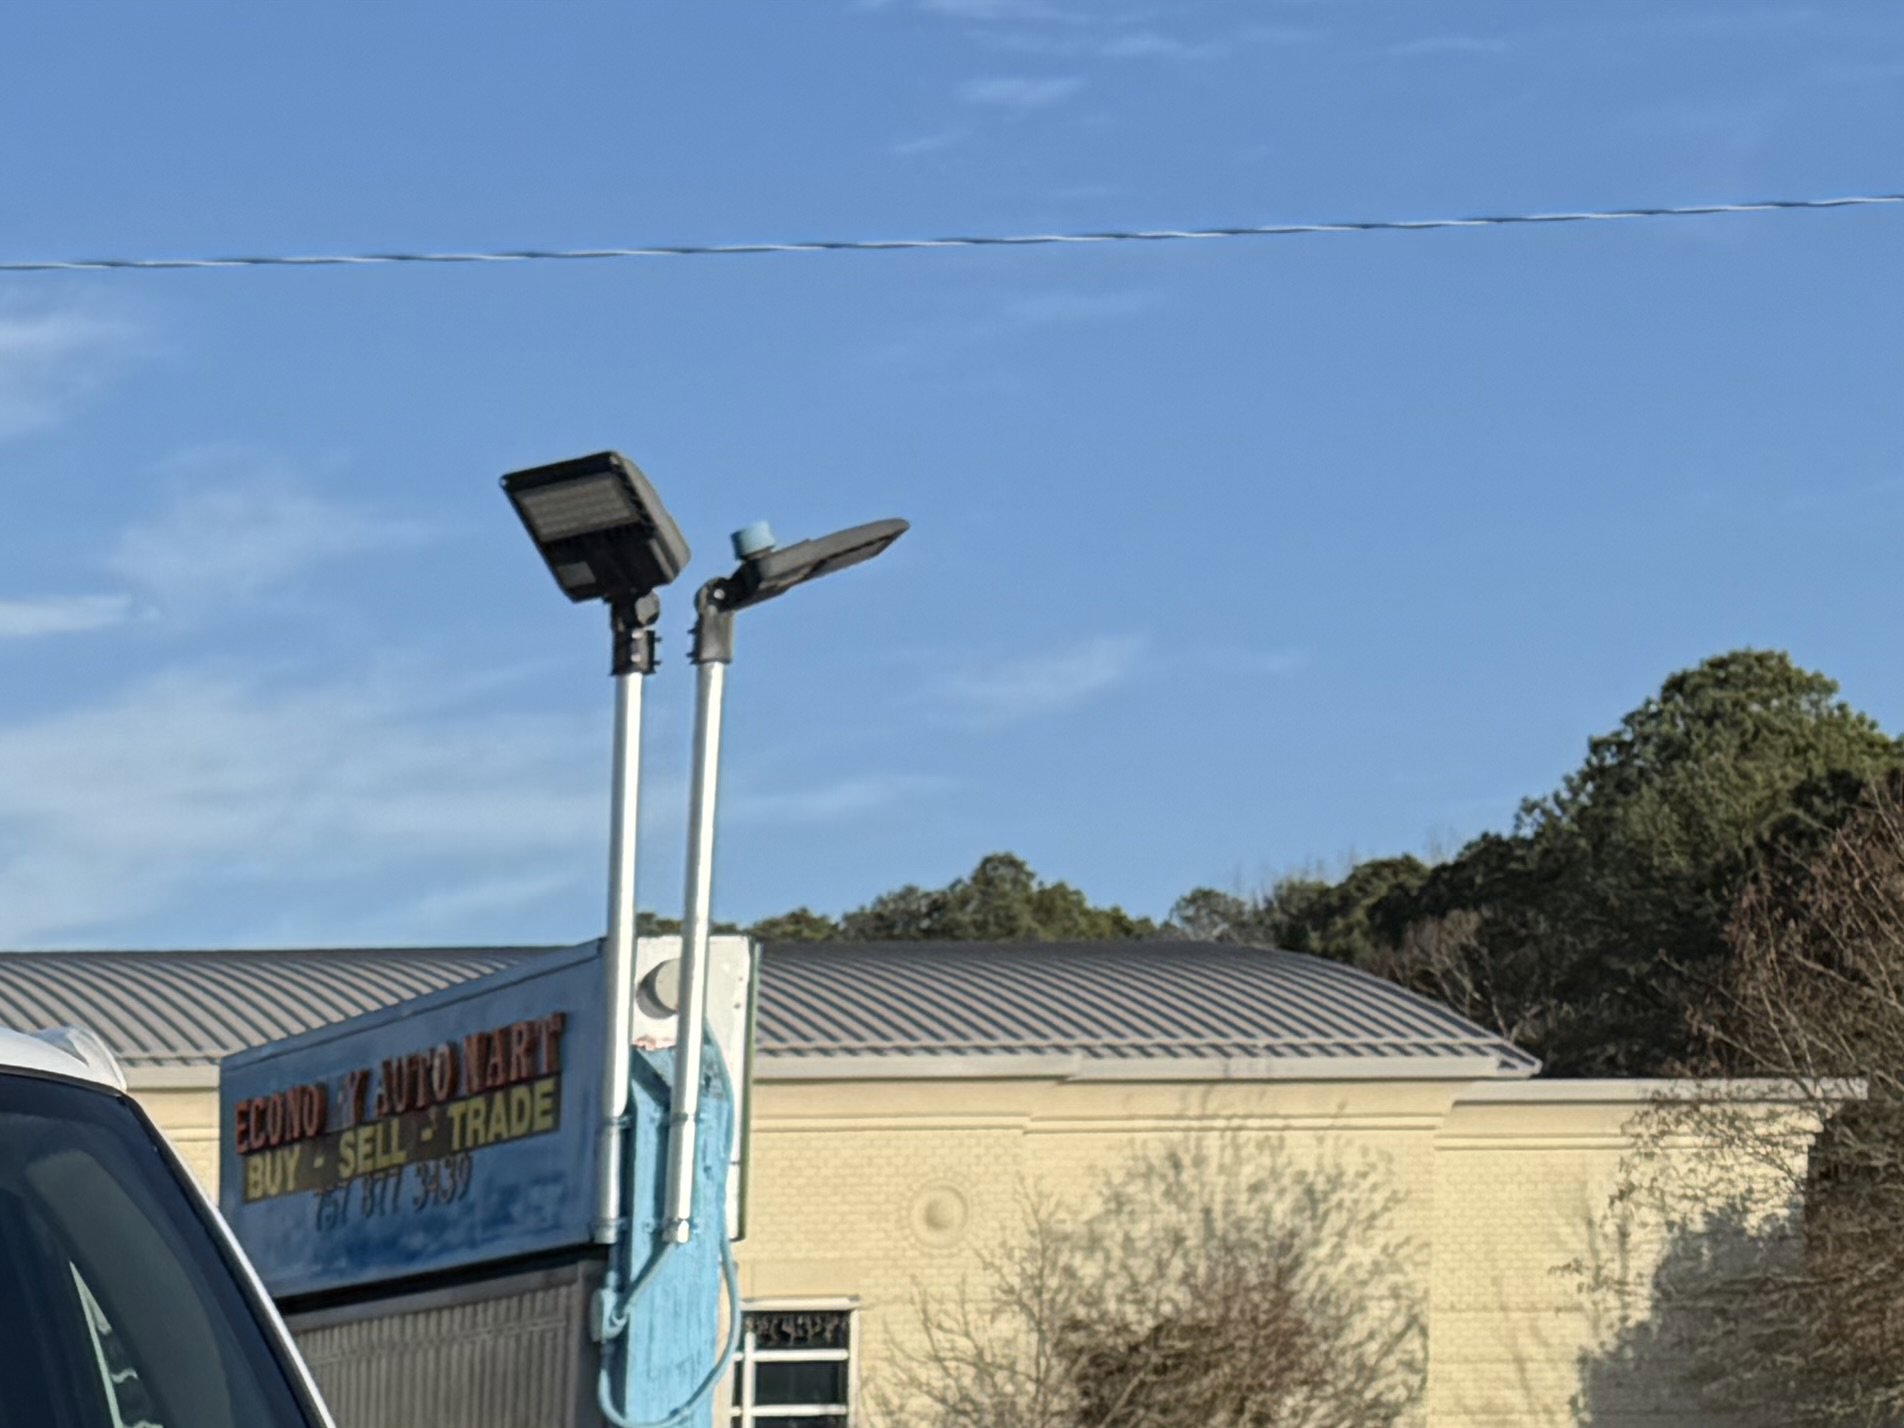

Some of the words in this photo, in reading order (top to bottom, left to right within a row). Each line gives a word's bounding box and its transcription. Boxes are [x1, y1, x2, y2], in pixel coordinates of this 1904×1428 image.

[235, 1068, 372, 1155] ECONOY
[377, 1043, 456, 1117] AUTO
[246, 1143, 302, 1200] BUY
[337, 1117, 408, 1180] SELL
[448, 1077, 557, 1151] TRADE
